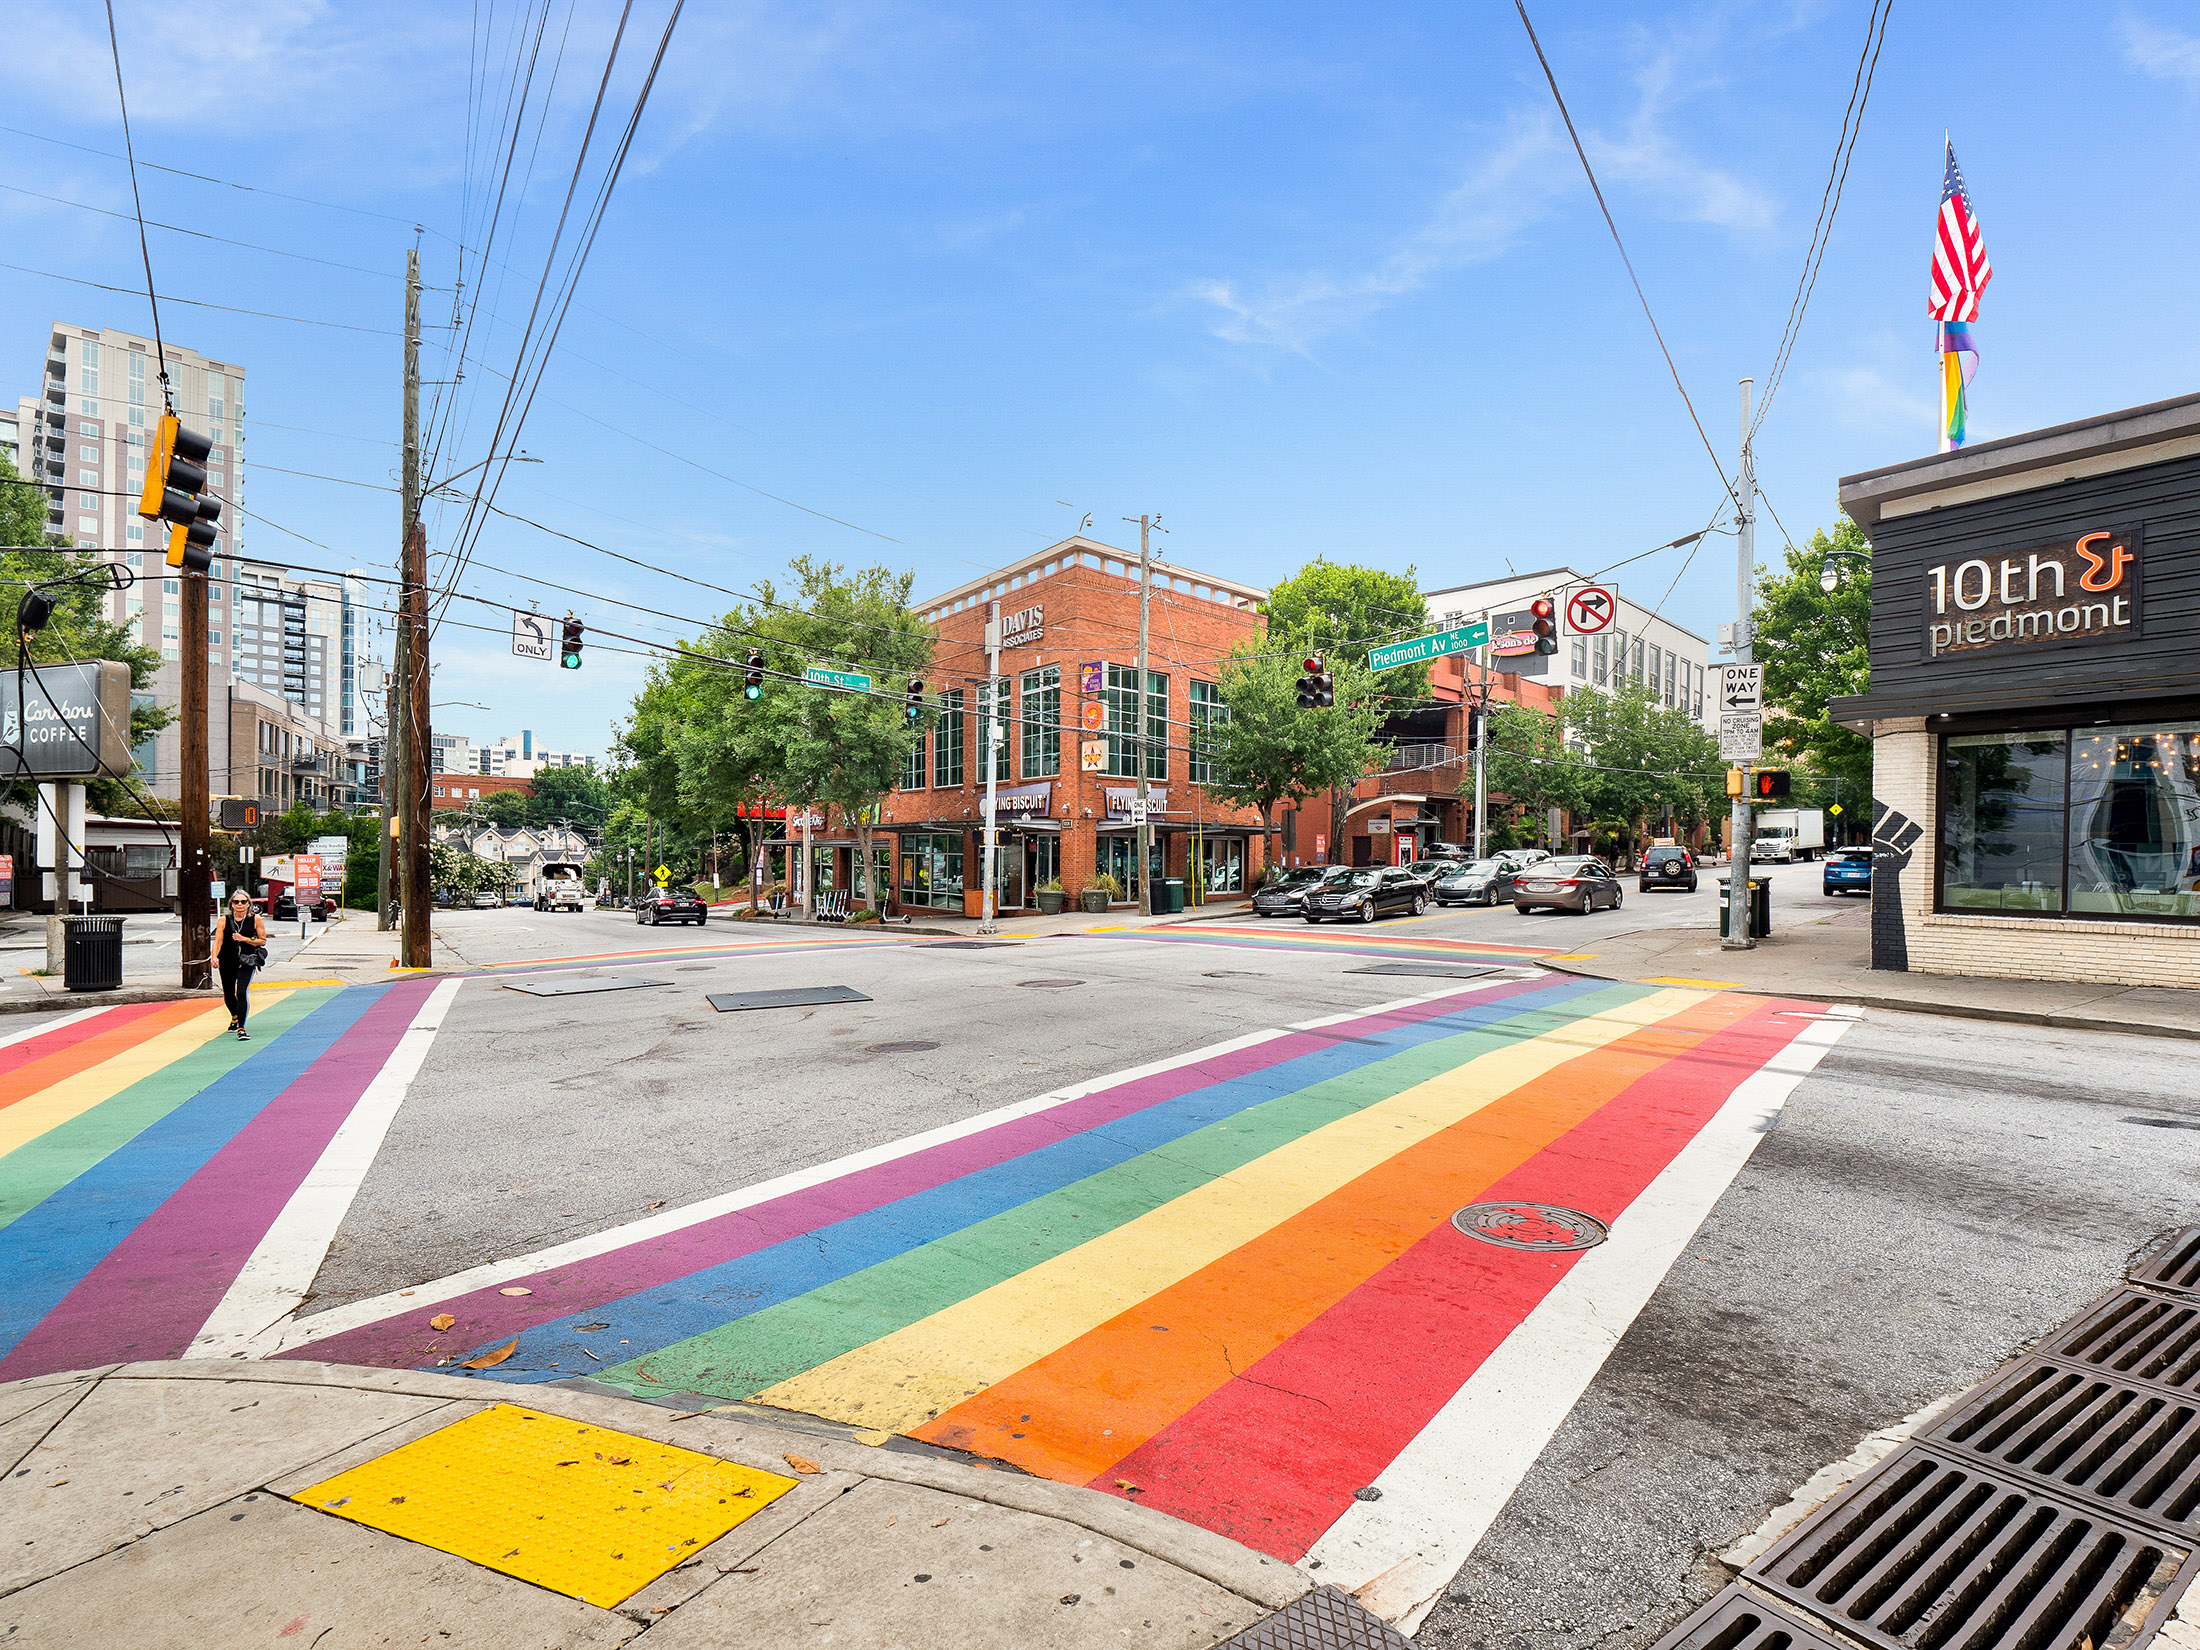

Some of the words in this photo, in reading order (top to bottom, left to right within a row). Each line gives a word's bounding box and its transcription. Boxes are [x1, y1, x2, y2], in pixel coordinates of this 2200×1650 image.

[1927, 553, 2065, 615] 10th
[1002, 604, 1044, 637] DAVIS
[1929, 595, 2131, 658] piedmont
[1002, 628, 1044, 647] ASSOCIATES
[1450, 631, 1459, 641] NE
[517, 643, 548, 656] ONLY
[1372, 644, 1426, 667] Piedmont
[1431, 639, 1446, 653] Av
[1451, 640, 1468, 650] 1000
[810, 671, 830, 683] 10th
[834, 675, 844, 687] St
[1727, 668, 1758, 679] ONE
[1726, 682, 1757, 693] WAY
[1732, 716, 1759, 724] CRUISING
[30, 725, 87, 743] COFFEE
[1013, 794, 1043, 809] BISCUIT
[1112, 795, 1137, 811] FLYIN
[1147, 798, 1168, 811] SCUIT
[245, 806, 256, 824] 10
